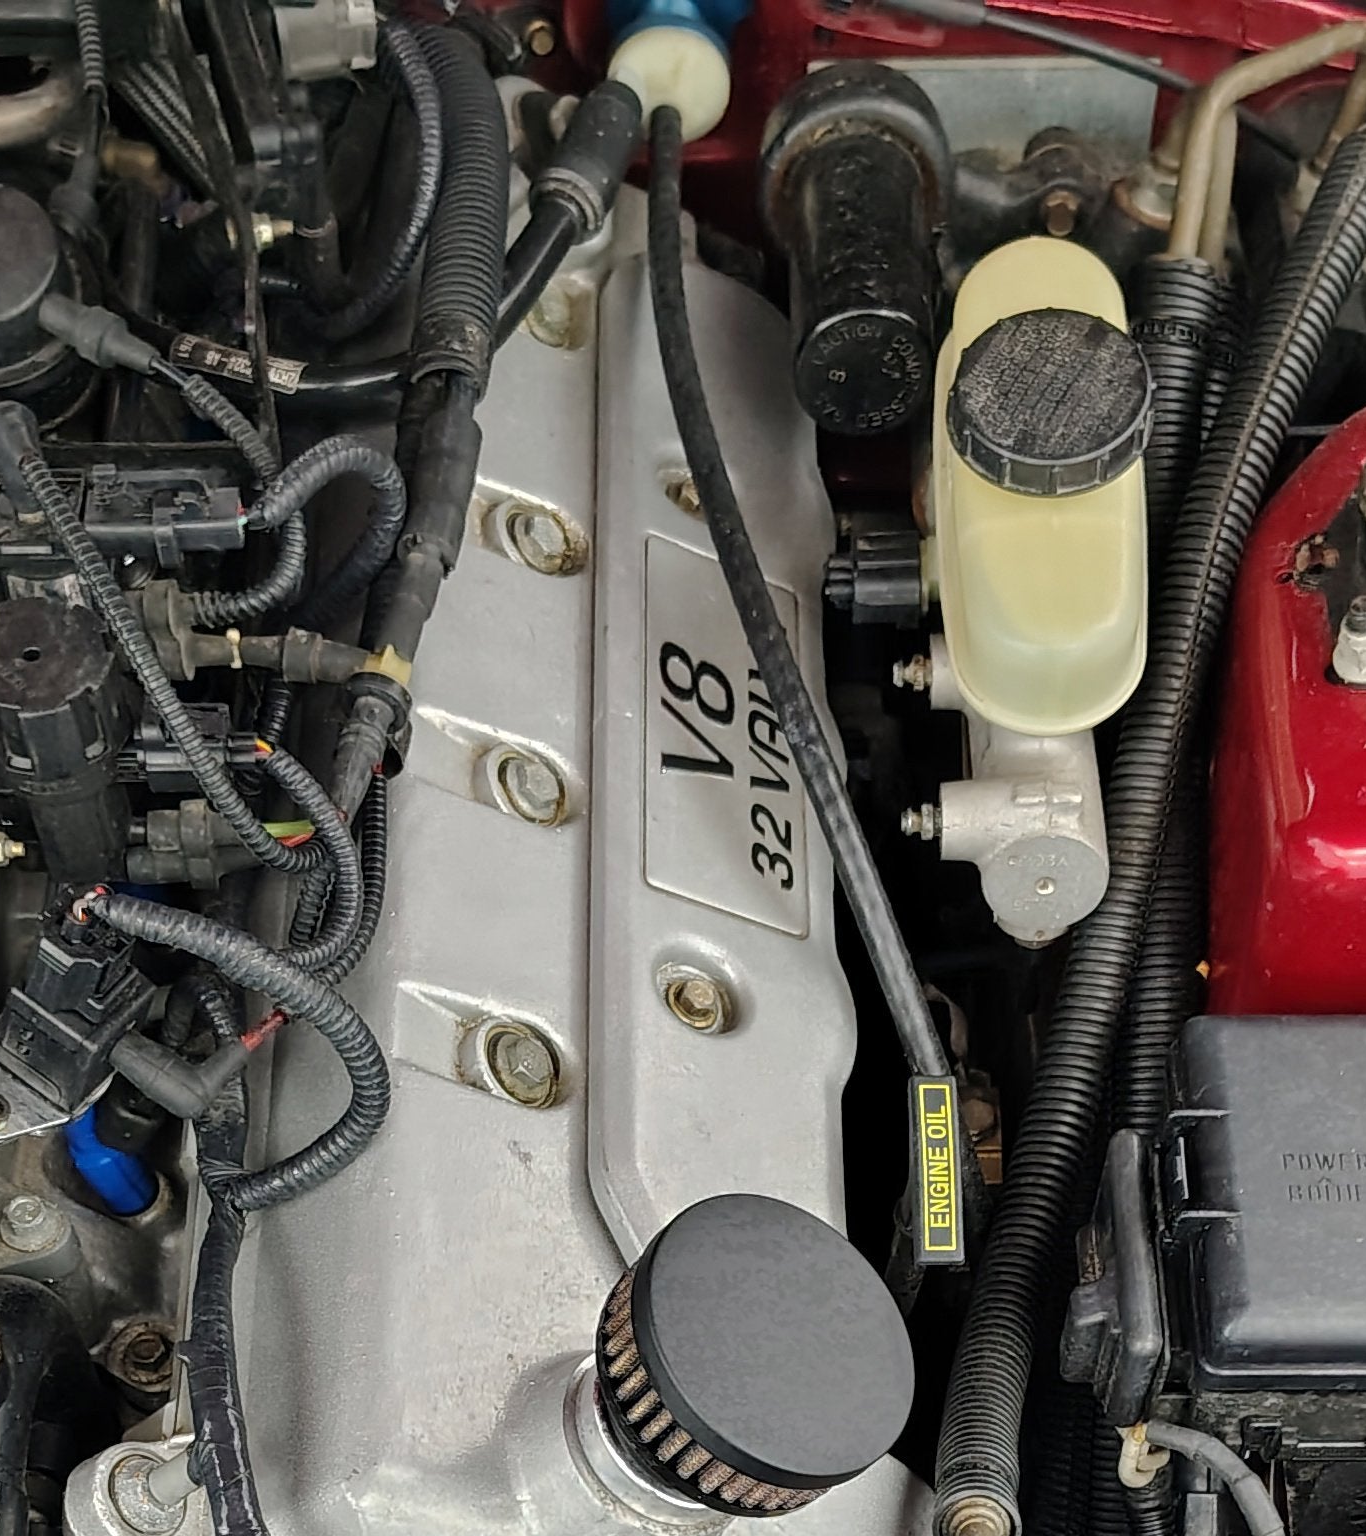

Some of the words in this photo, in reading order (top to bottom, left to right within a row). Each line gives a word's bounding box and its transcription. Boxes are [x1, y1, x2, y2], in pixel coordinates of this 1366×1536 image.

[660, 641, 735, 779] V8
[747, 668, 791, 793] VA
[751, 803, 794, 892] 32
[926, 1105, 947, 1139] OIL
[928, 1146, 950, 1228] ENGINE
